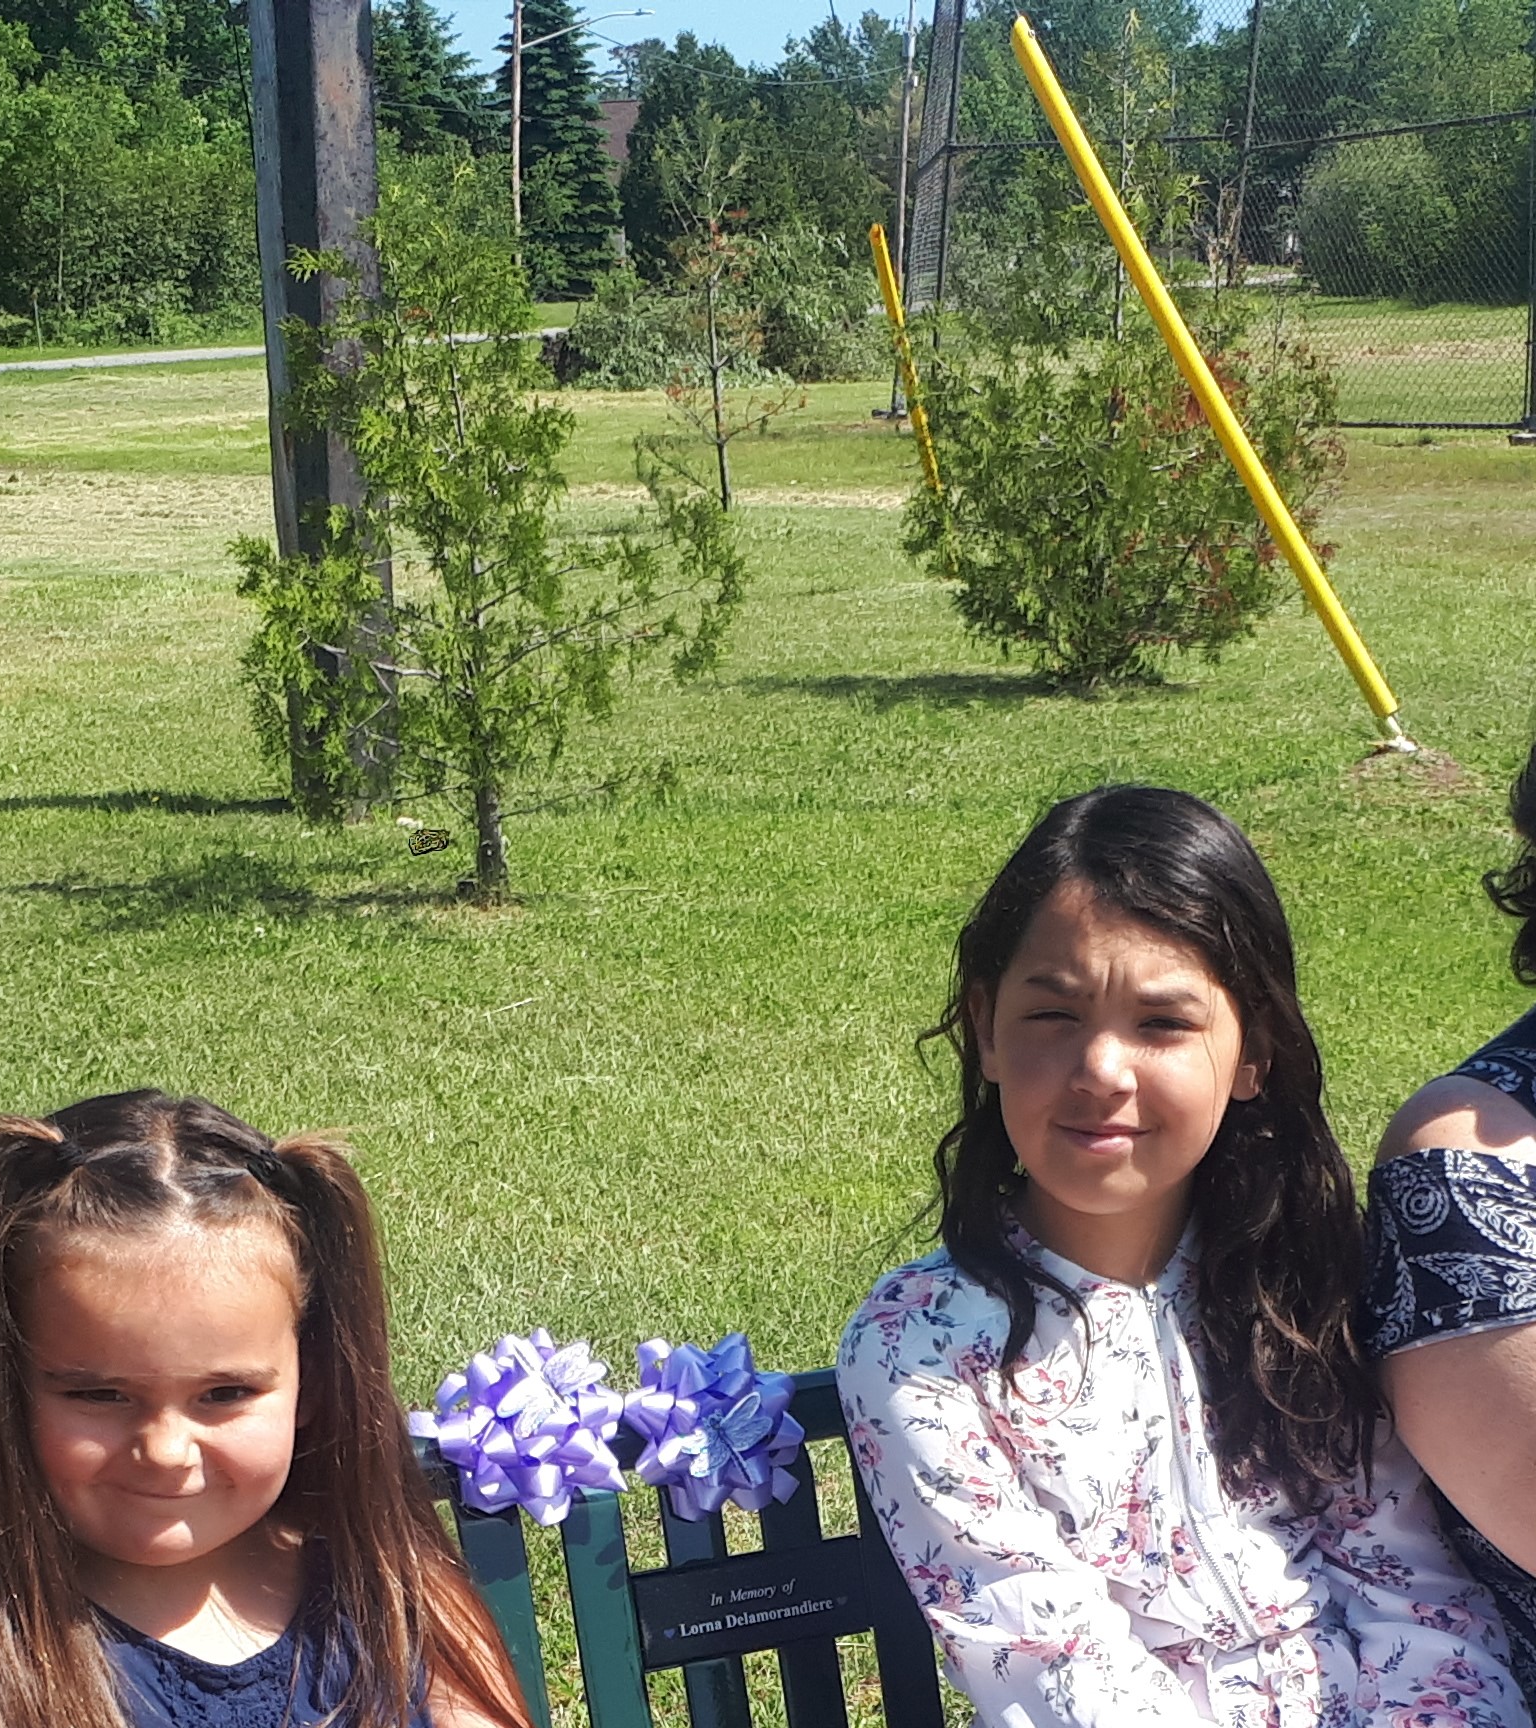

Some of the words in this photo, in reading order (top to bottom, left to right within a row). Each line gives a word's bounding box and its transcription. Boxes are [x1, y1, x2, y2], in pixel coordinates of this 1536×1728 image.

[711, 1593, 722, 1606] In
[730, 1586, 776, 1602] Memory
[782, 1579, 795, 1594] of
[681, 1621, 722, 1637] Lorna
[726, 1601, 834, 1628] Delamorandiere
